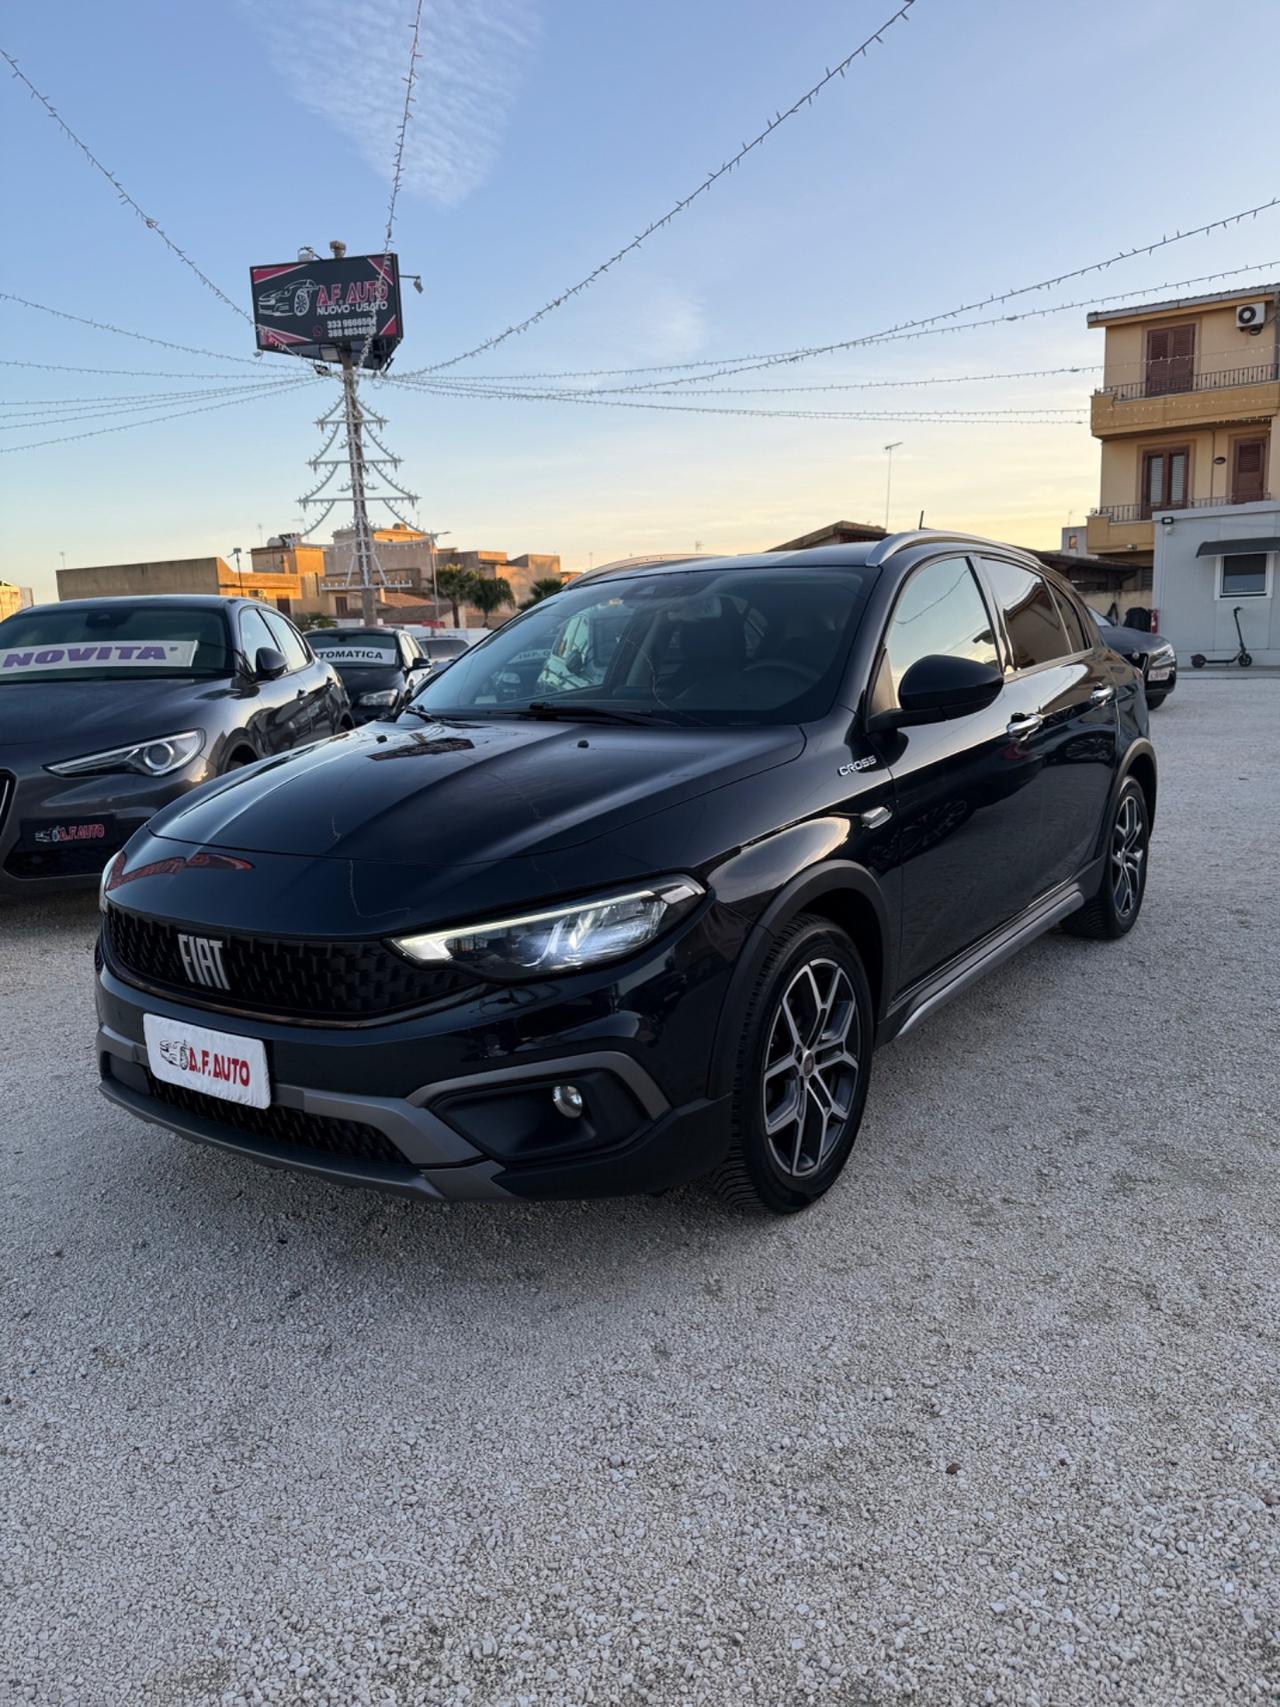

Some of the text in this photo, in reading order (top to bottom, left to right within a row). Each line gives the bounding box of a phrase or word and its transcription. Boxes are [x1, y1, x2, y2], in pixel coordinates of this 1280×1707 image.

[317, 300, 388, 316] NUOVO USATO
[327, 320, 342, 329] 333
[319, 650, 383, 660] TOMATICA
[838, 755, 877, 776] CROSS
[177, 933, 231, 991] FIAT
